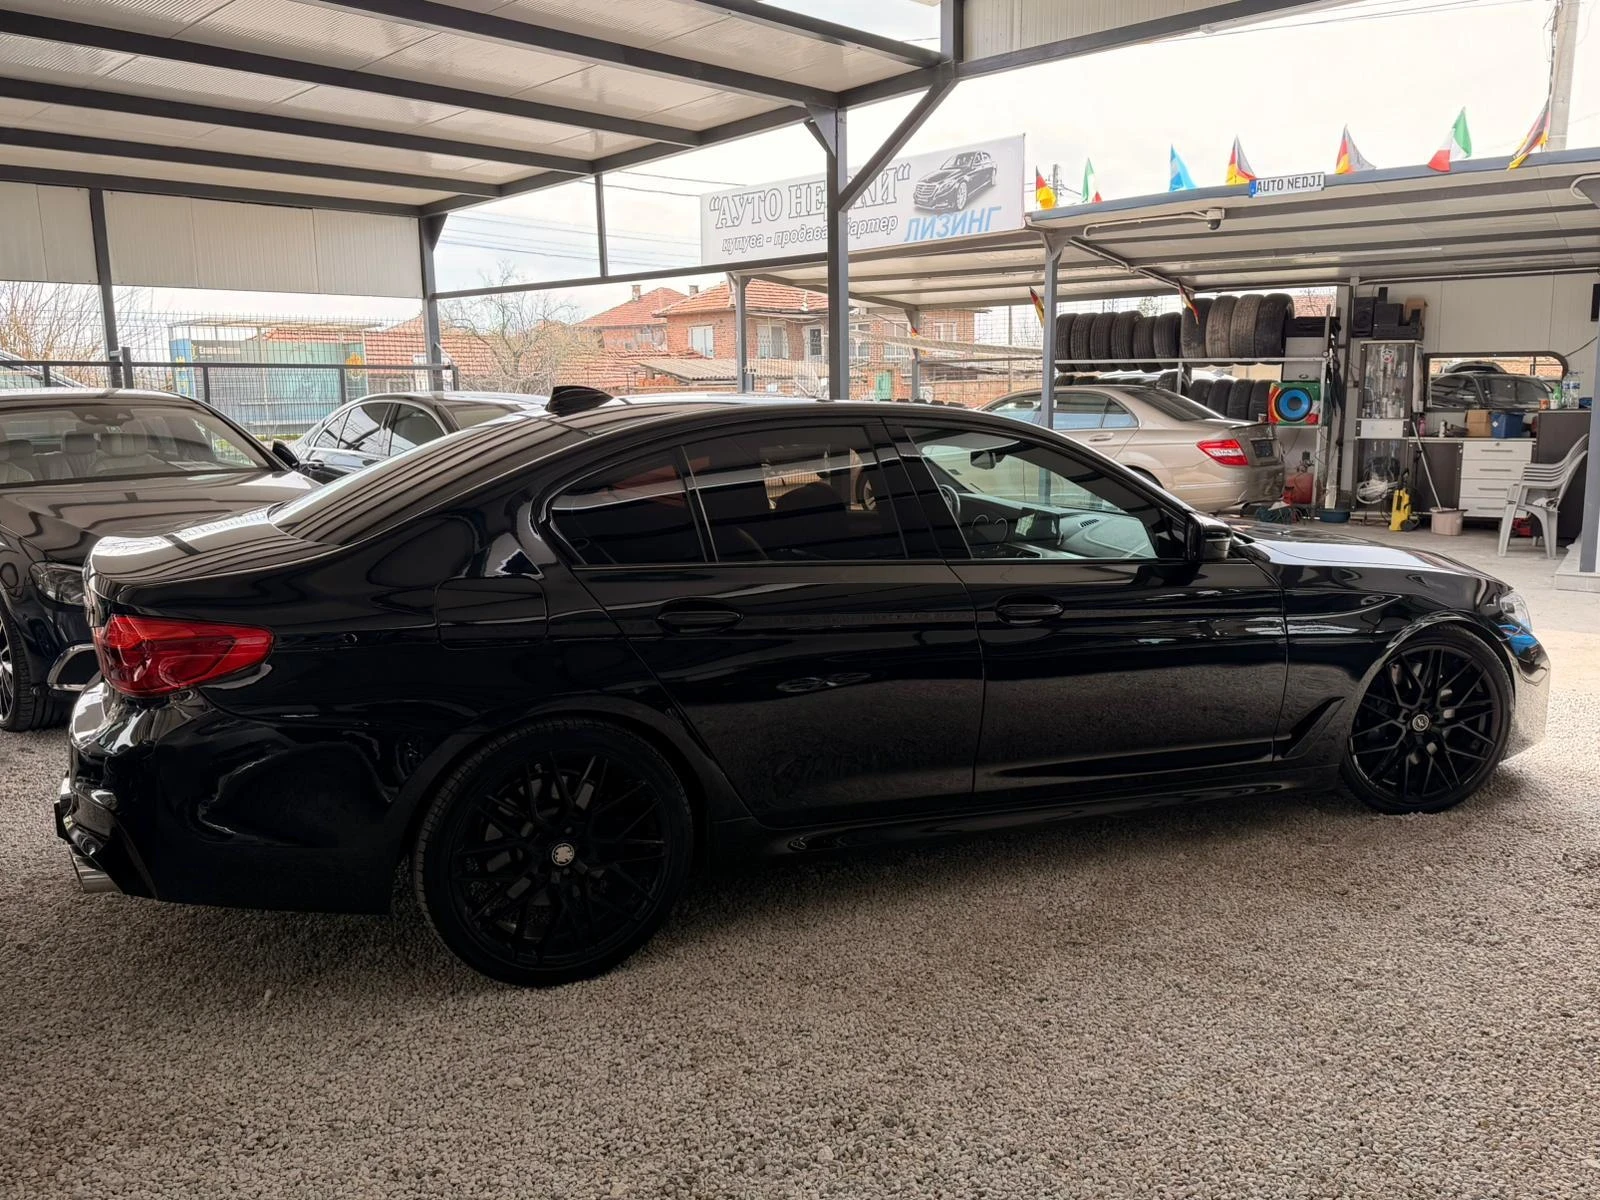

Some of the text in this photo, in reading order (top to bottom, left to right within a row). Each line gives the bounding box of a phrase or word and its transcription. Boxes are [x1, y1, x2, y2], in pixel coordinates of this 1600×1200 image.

[1257, 175, 1323, 193] AUTO NEDJI
[721, 234, 764, 256] купува
[847, 215, 899, 239] артер
[904, 206, 1002, 242] ЛИЗИНГ
